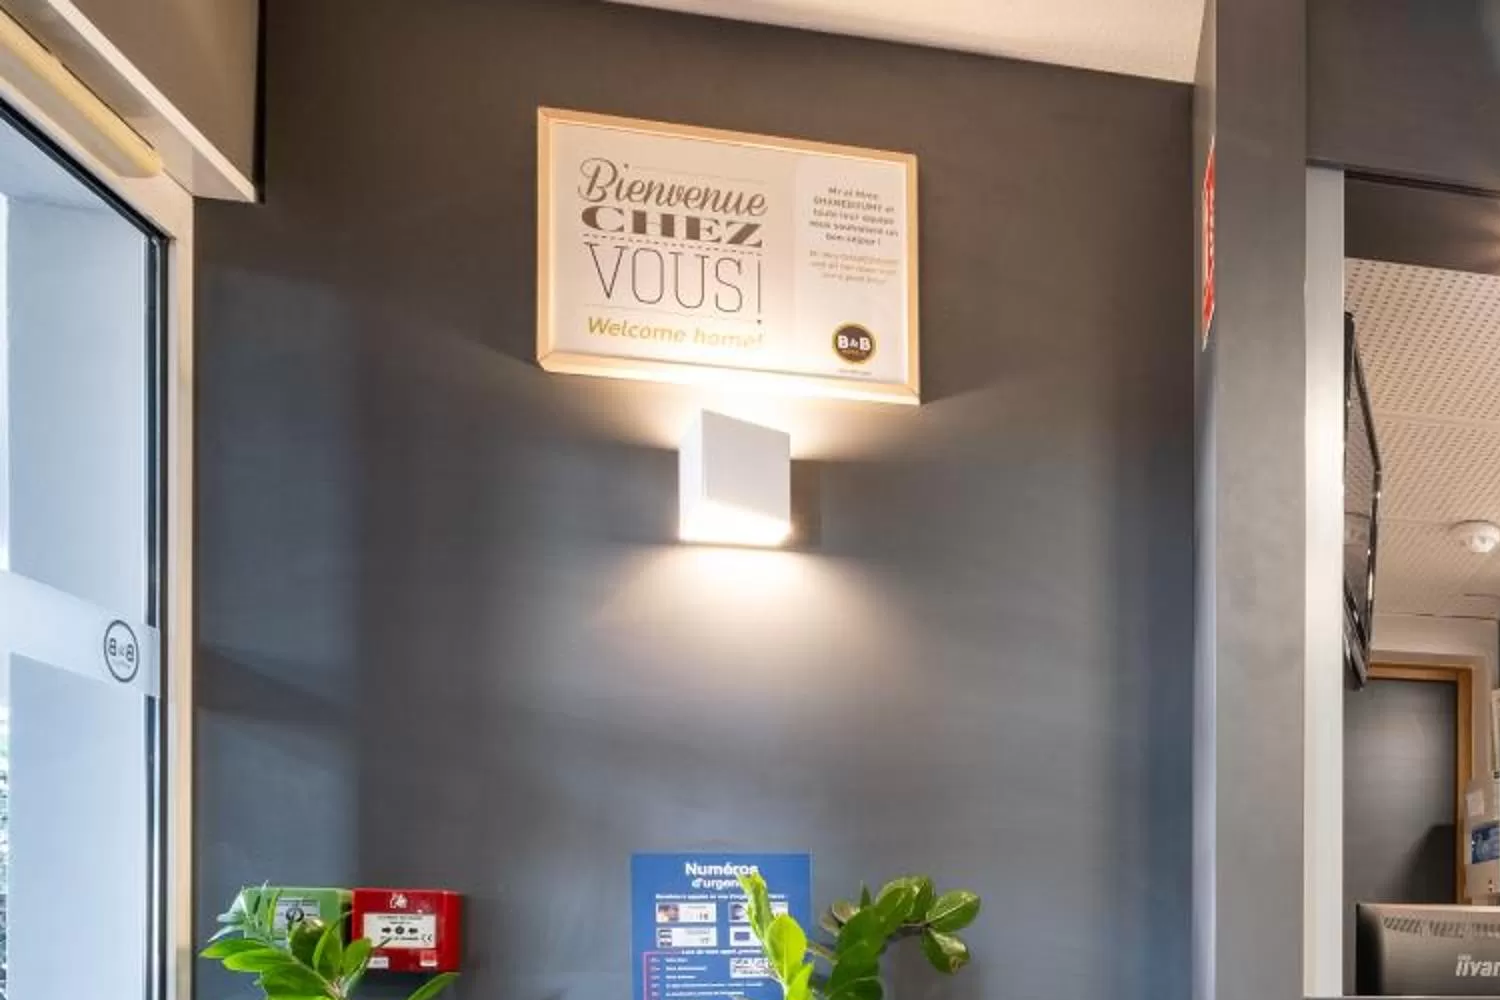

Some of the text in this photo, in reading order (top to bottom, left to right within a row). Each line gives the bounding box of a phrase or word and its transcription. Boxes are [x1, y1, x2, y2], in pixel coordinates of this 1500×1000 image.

[578, 157, 769, 216] Bienvenue
[581, 205, 763, 248] CHEZ
[583, 241, 764, 324] VOUS!
[587, 315, 764, 349] Welcome home!
